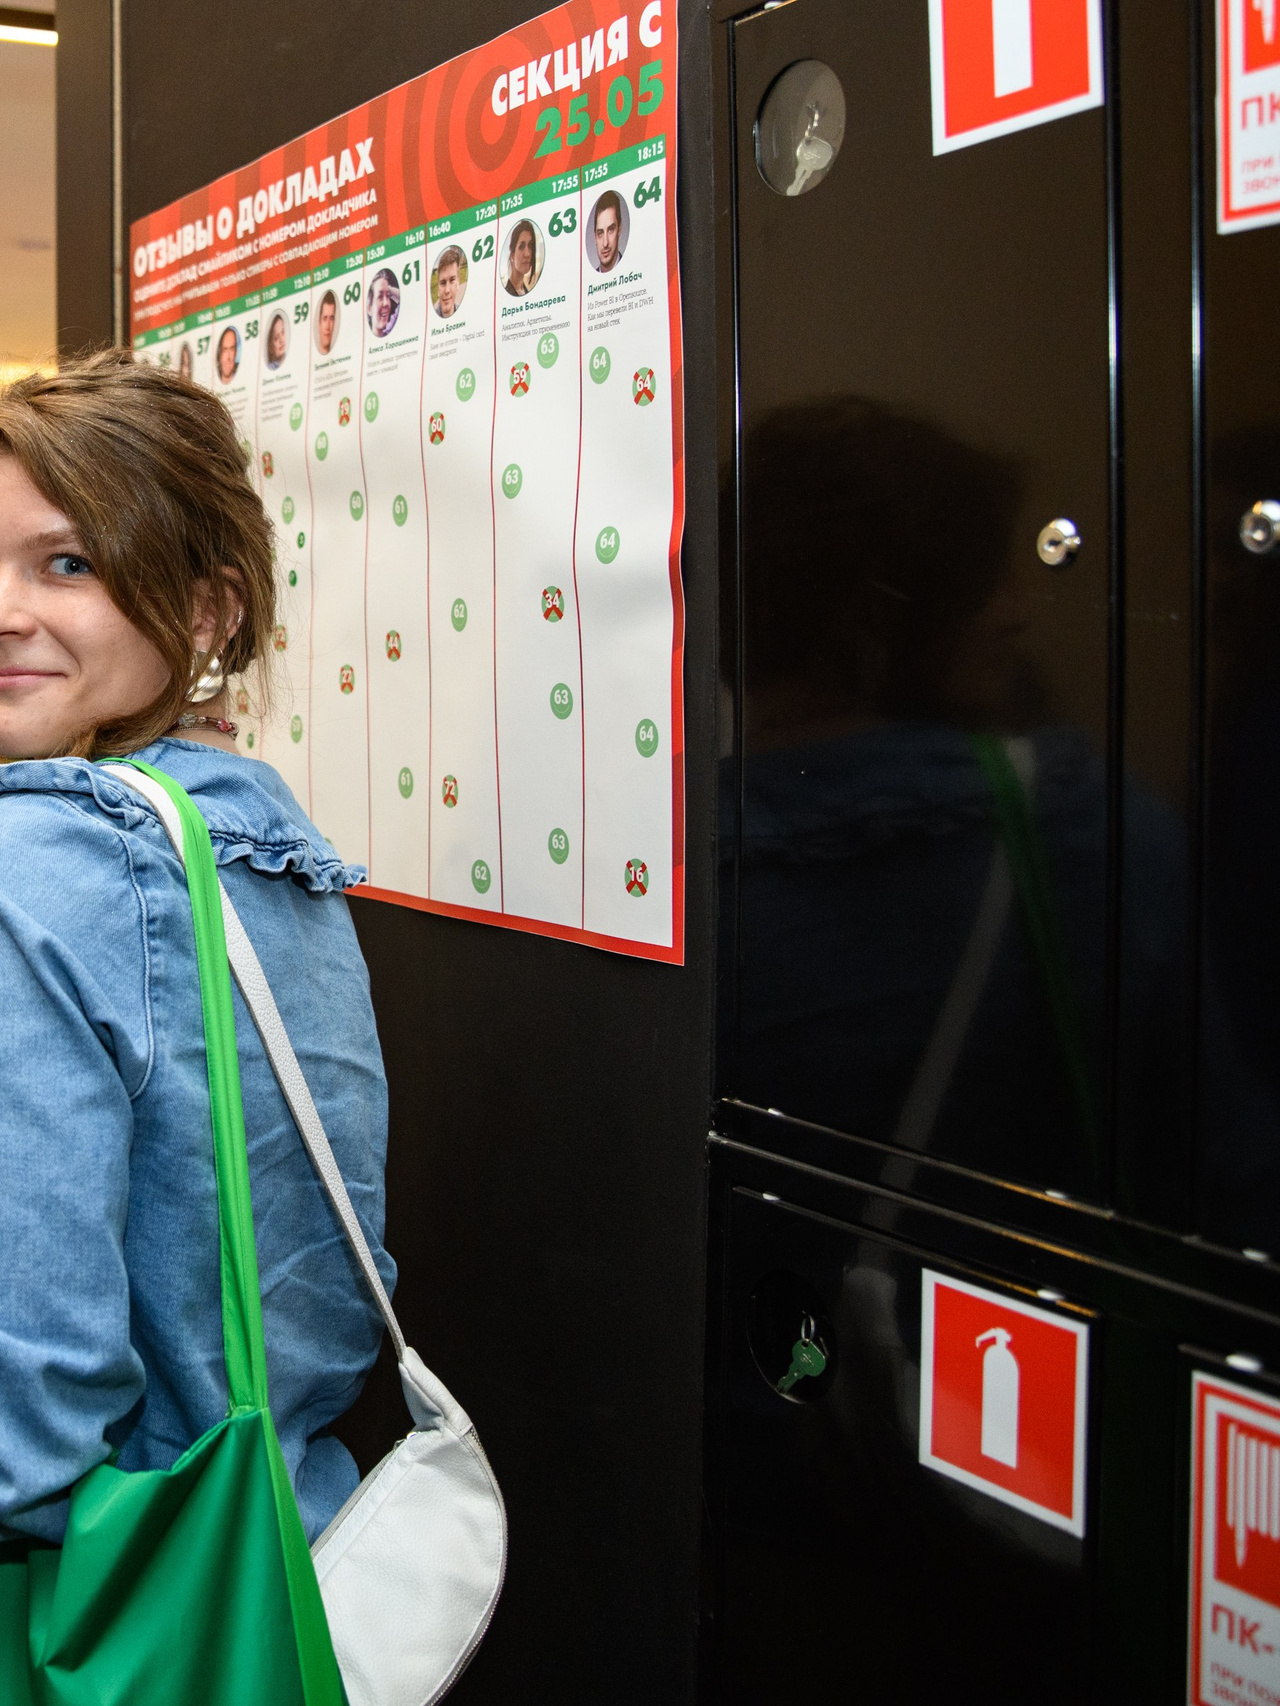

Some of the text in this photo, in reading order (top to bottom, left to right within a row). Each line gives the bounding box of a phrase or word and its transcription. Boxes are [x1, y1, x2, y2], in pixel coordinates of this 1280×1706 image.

[491, 0, 662, 116] СЕКЦИЯ С
[533, 59, 665, 160] 25.05
[584, 140, 664, 183] 17:55 18:15
[501, 175, 579, 212] 17:35 17:55
[633, 175, 662, 209] 64
[133, 137, 375, 278] ОТЗЫВЫ О ДОКЛАДАХ
[259, 219, 306, 250] НОМЕРОМ
[306, 187, 377, 234] ДОКЛАДЧИКА
[338, 214, 378, 239] НОМЕРОМ
[428, 203, 497, 238] 16:40 17:20
[548, 207, 577, 238] 63
[367, 229, 425, 262] 15:30 16:10
[471, 234, 495, 263] 62
[402, 260, 420, 286] 61
[587, 271, 643, 296] Дмитрий Лобач
[343, 281, 361, 306] 60
[594, 297, 608, 309] Power
[293, 302, 309, 325] 59
[501, 294, 566, 318] Дарья Бондарева
[587, 311, 598, 322] Как
[638, 296, 654, 310] DWH
[245, 320, 259, 342] 58
[197, 335, 211, 356] 57
[540, 338, 555, 355] 63
[592, 351, 607, 369] 64
[459, 373, 472, 389] 62
[513, 368, 527, 384] 59
[636, 374, 652, 393] 64
[367, 396, 377, 411] 61
[431, 418, 442, 432] 60
[505, 469, 519, 486] 63
[394, 500, 405, 515] 61
[599, 532, 616, 549] 64
[453, 603, 465, 619] 62
[545, 593, 560, 609] 34
[553, 689, 569, 705] 63
[638, 725, 654, 742] 64
[400, 772, 411, 787] 61
[551, 834, 566, 850] 63
[474, 865, 487, 881] 62
[628, 866, 644, 883] 16
